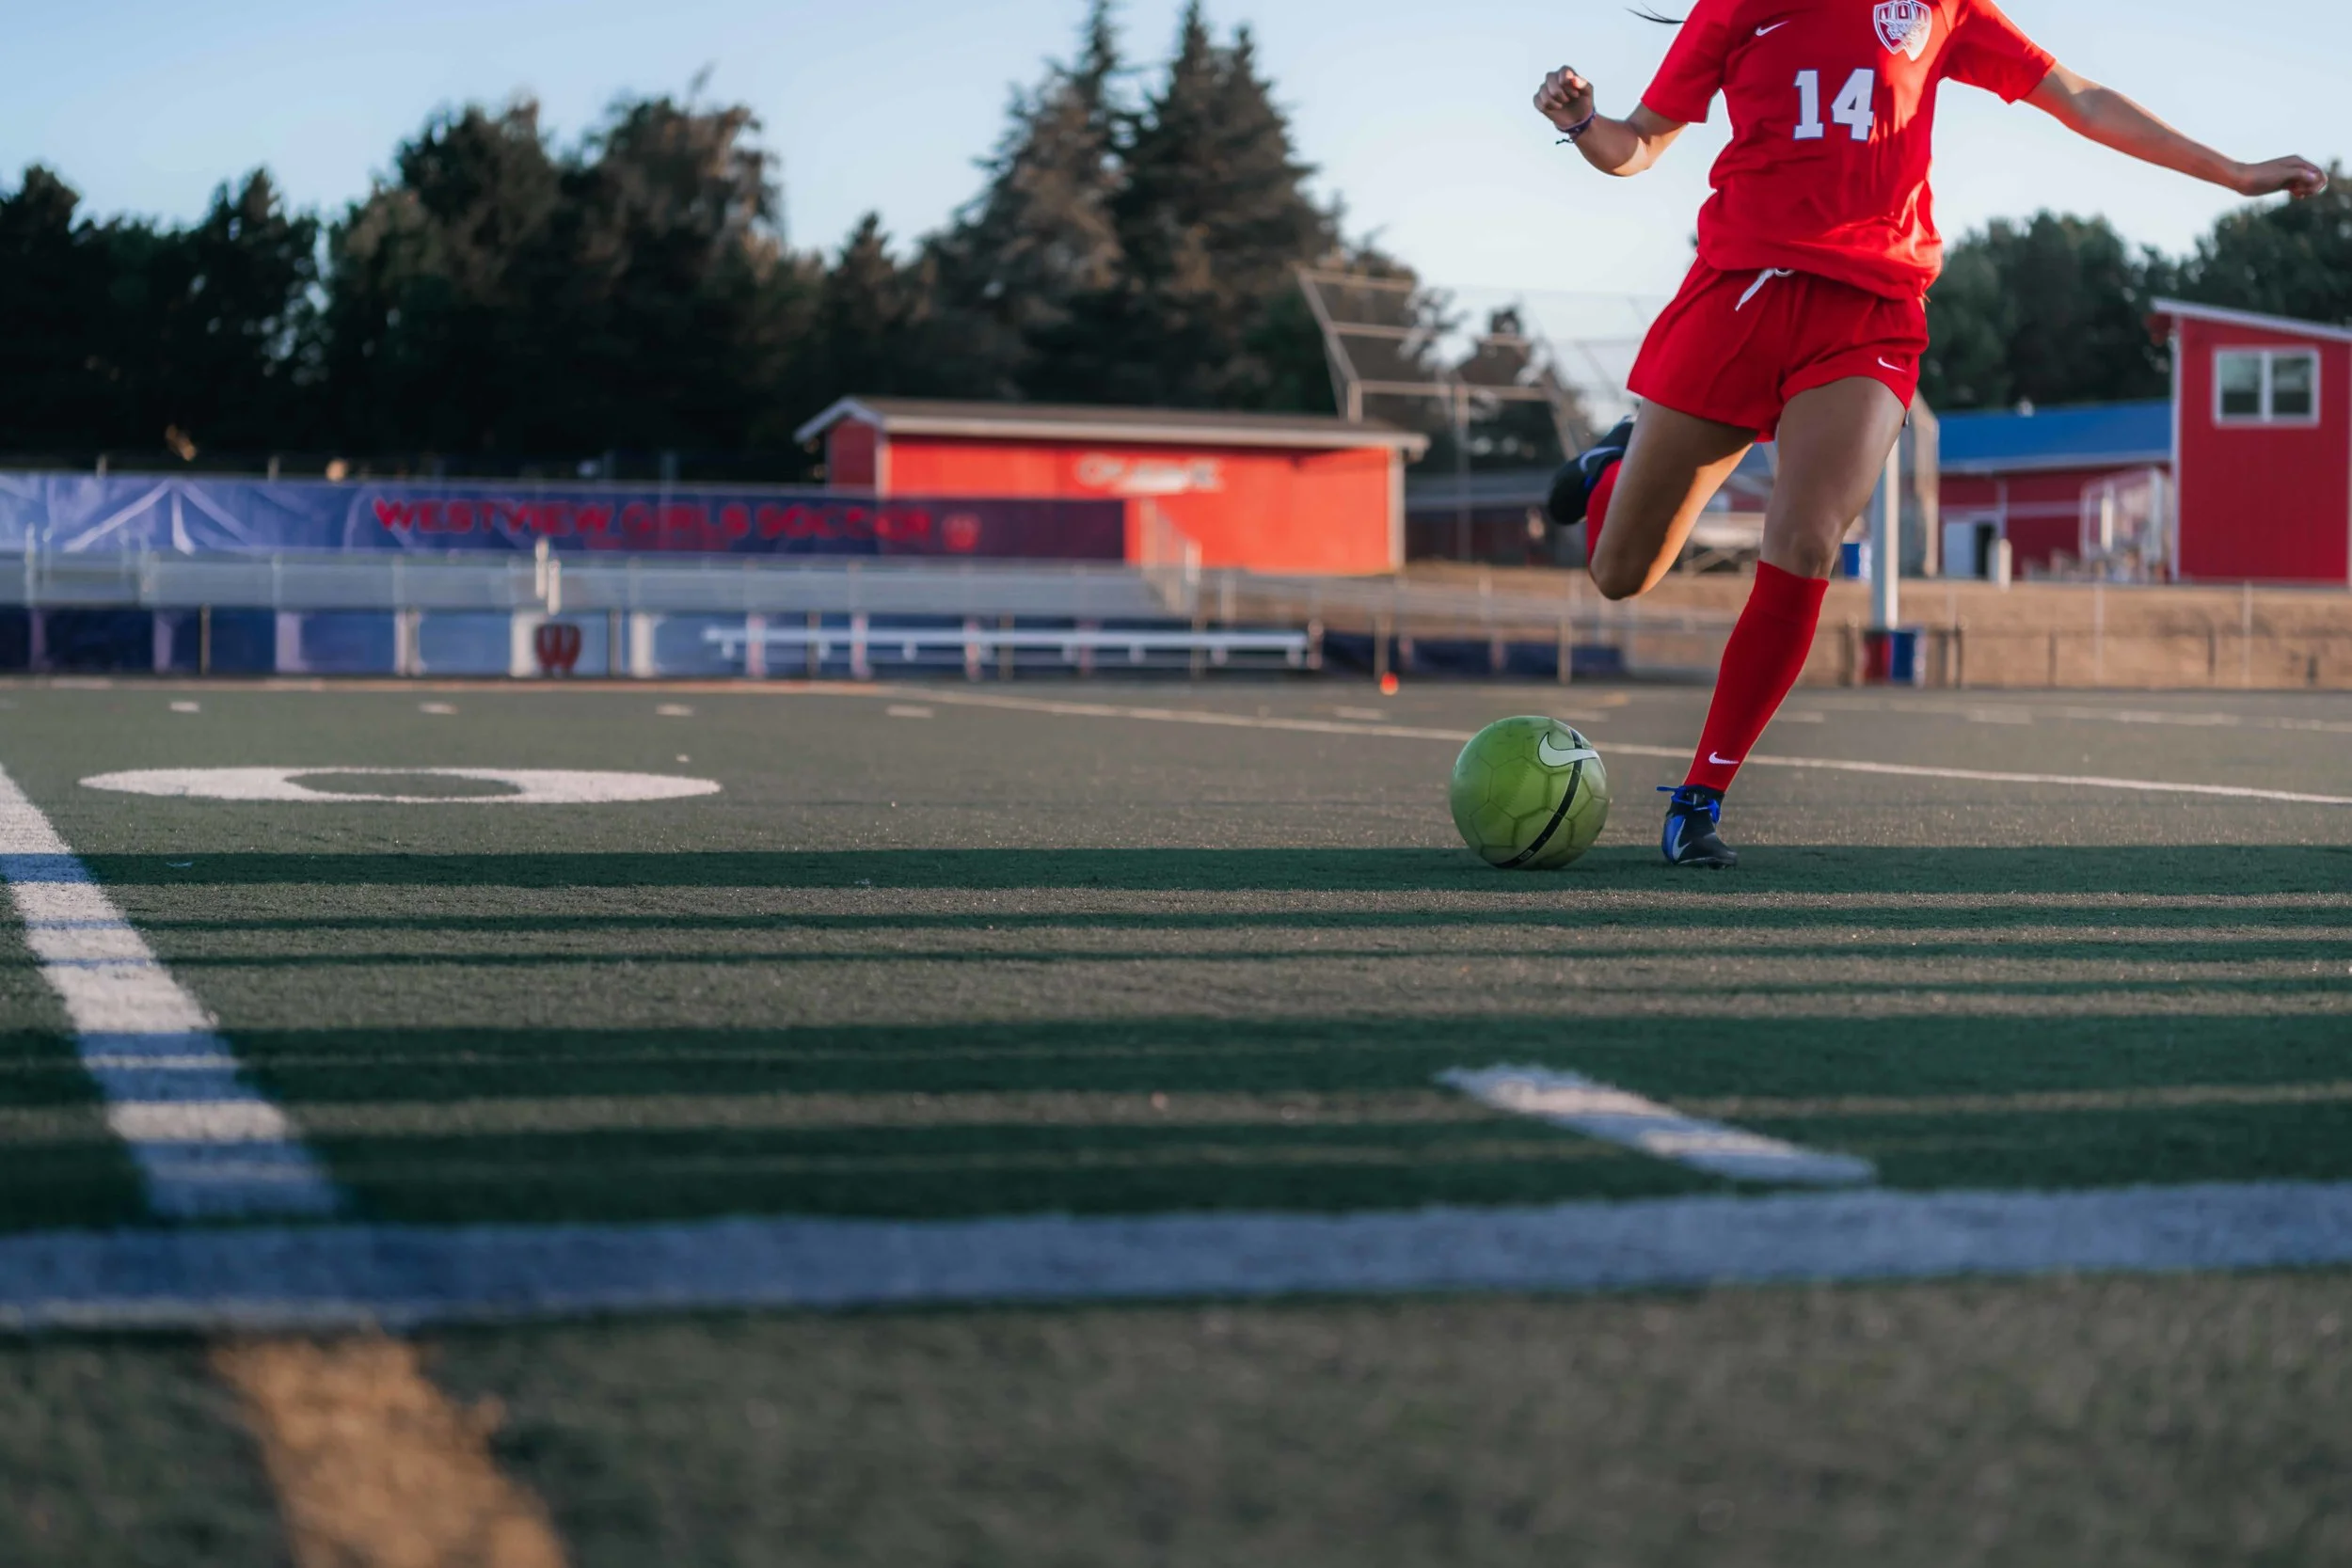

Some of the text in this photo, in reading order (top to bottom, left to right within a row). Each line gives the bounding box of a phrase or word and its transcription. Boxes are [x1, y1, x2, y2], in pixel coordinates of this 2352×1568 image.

[1792, 68, 1875, 140] 14
[373, 497, 931, 542] WESTVIEW GIRLS SOCCER
